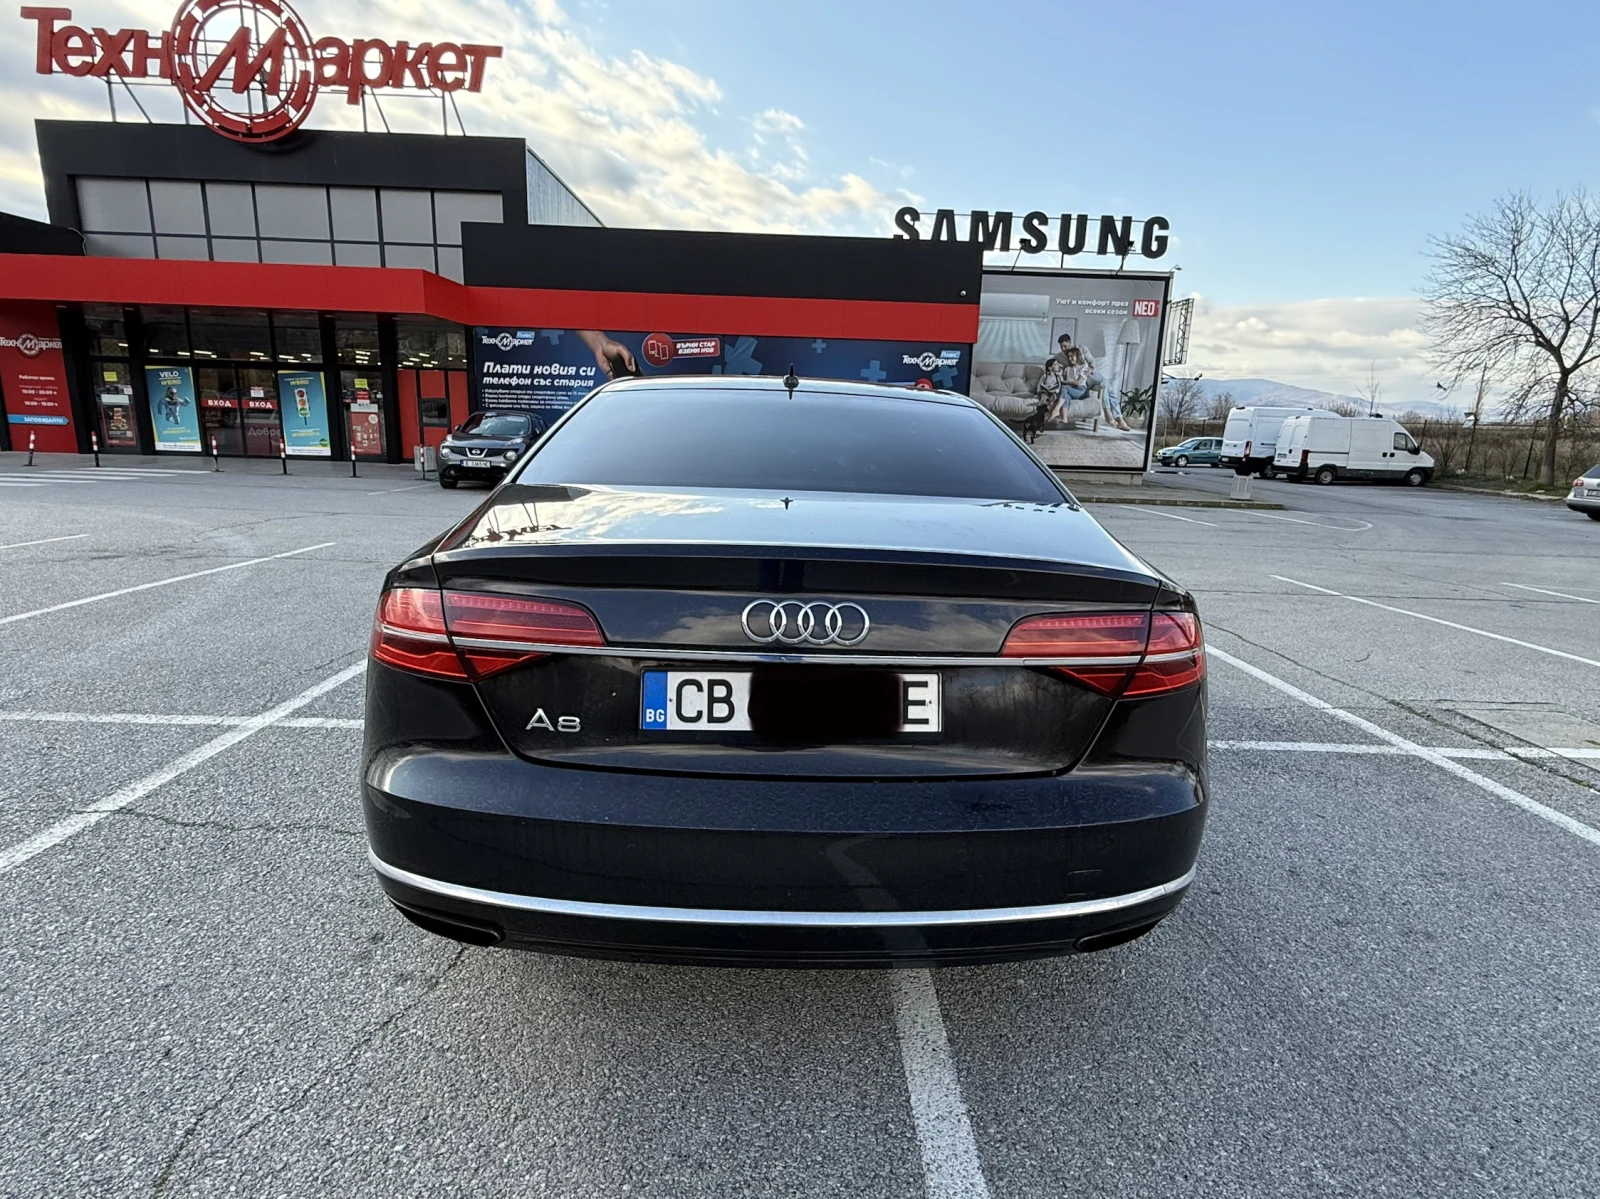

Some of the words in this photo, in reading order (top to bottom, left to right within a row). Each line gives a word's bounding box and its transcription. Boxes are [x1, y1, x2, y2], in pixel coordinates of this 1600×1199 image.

[895, 207, 1170, 259] SAMSUNG
[1078, 299, 1110, 307] комфорт
[1134, 301, 1156, 316] NEO
[483, 362, 531, 374] Плати
[533, 363, 577, 376] новия
[579, 367, 597, 376] си
[483, 376, 532, 387] телефон
[534, 378, 552, 386] със
[554, 379, 594, 388] стария
[249, 401, 273, 409] ВХОД
[676, 678, 735, 723] CB
[525, 708, 581, 733] A8
[645, 708, 665, 722] BG
